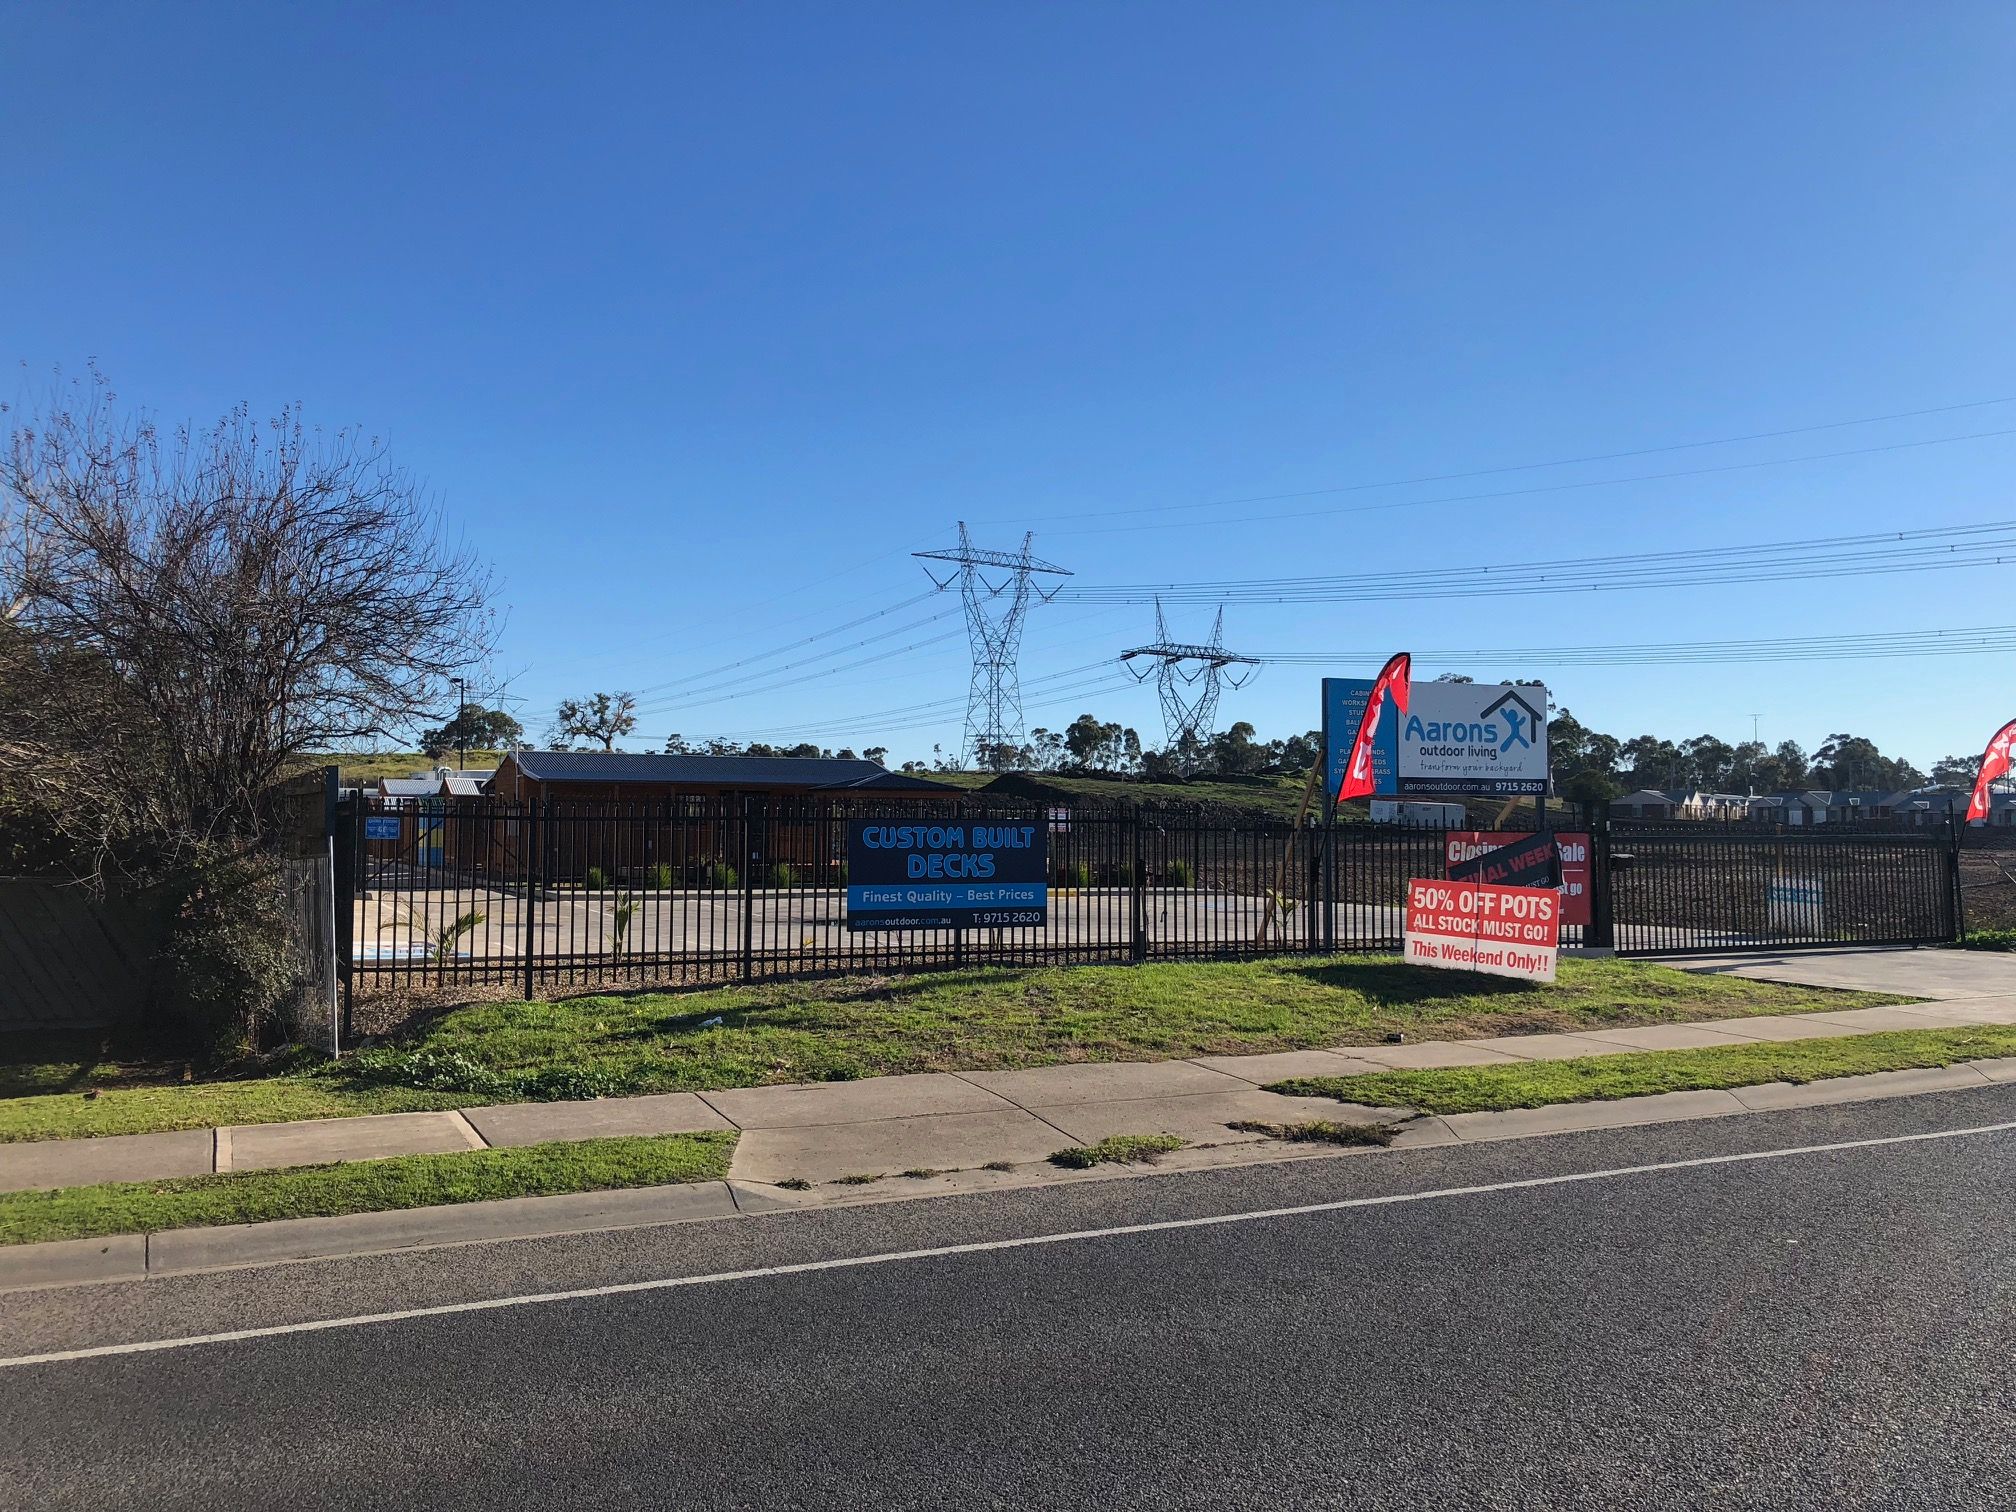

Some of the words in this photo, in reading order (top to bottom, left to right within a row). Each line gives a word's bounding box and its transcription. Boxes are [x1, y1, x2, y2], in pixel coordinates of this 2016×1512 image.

[1404, 715, 1498, 743] Aarons
[1420, 744, 1465, 757] outdoor
[1468, 745, 1498, 761] living
[1420, 760, 1460, 773] transform
[1462, 764, 1482, 776] your
[1485, 762, 1523, 776] backyard
[1404, 782, 1491, 792] aaronsoutdoor.com.au
[1495, 782, 1519, 792] 9715
[1520, 782, 1544, 792] 2620
[862, 826, 965, 849] CUSTOM
[972, 826, 1036, 849] BUILT
[907, 853, 996, 879] DECKS
[863, 891, 902, 903] Finest
[906, 890, 952, 904] Quality
[967, 889, 995, 901] Best
[998, 889, 1035, 900] Prices
[1570, 883, 1583, 896] go
[1413, 887, 1455, 911] 50%
[1458, 890, 1497, 915] OFF
[1500, 894, 1552, 921] POTS
[854, 917, 952, 927] aaronsoutdoor.com.au
[973, 913, 982, 924] T:
[983, 912, 1010, 923] 9715
[1012, 911, 1041, 922] 2620
[1413, 913, 1436, 930] ALL
[1438, 916, 1480, 934] STOCK
[1483, 919, 1521, 939] MUST
[1523, 924, 1549, 941] GO!
[1412, 940, 1438, 959] This
[1441, 943, 1503, 967] Weekend
[1506, 951, 1549, 974] Only!!
